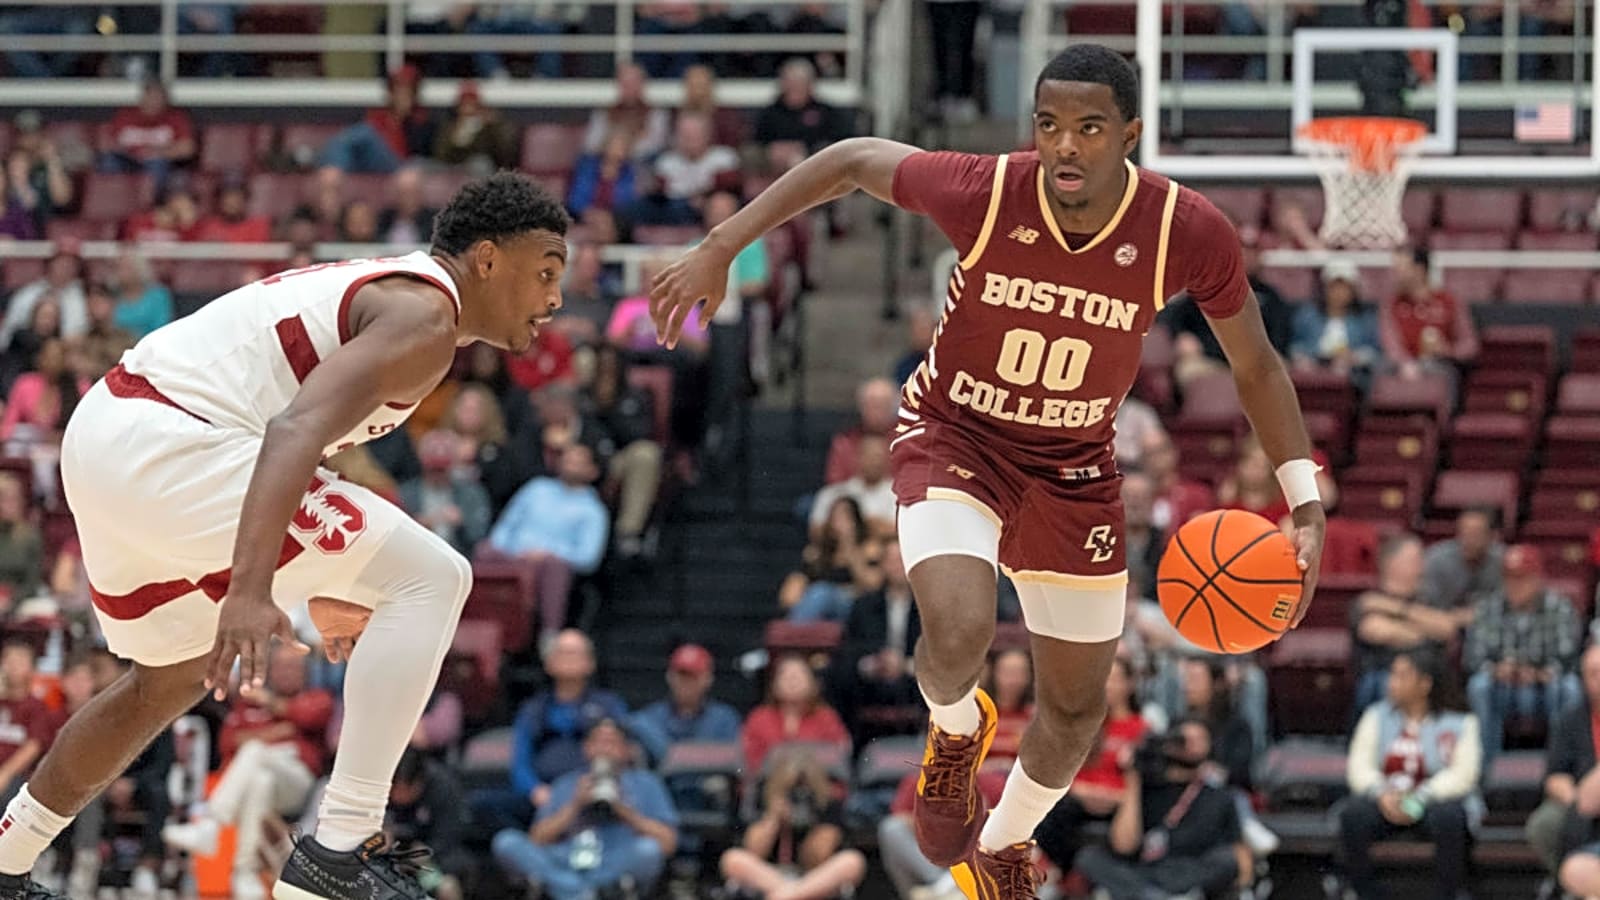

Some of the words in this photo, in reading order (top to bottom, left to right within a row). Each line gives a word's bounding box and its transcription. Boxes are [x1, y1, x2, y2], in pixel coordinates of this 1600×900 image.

[980, 272, 1140, 332] BOSTON
[995, 327, 1093, 392] 00
[948, 370, 1112, 428] COLLEGE
